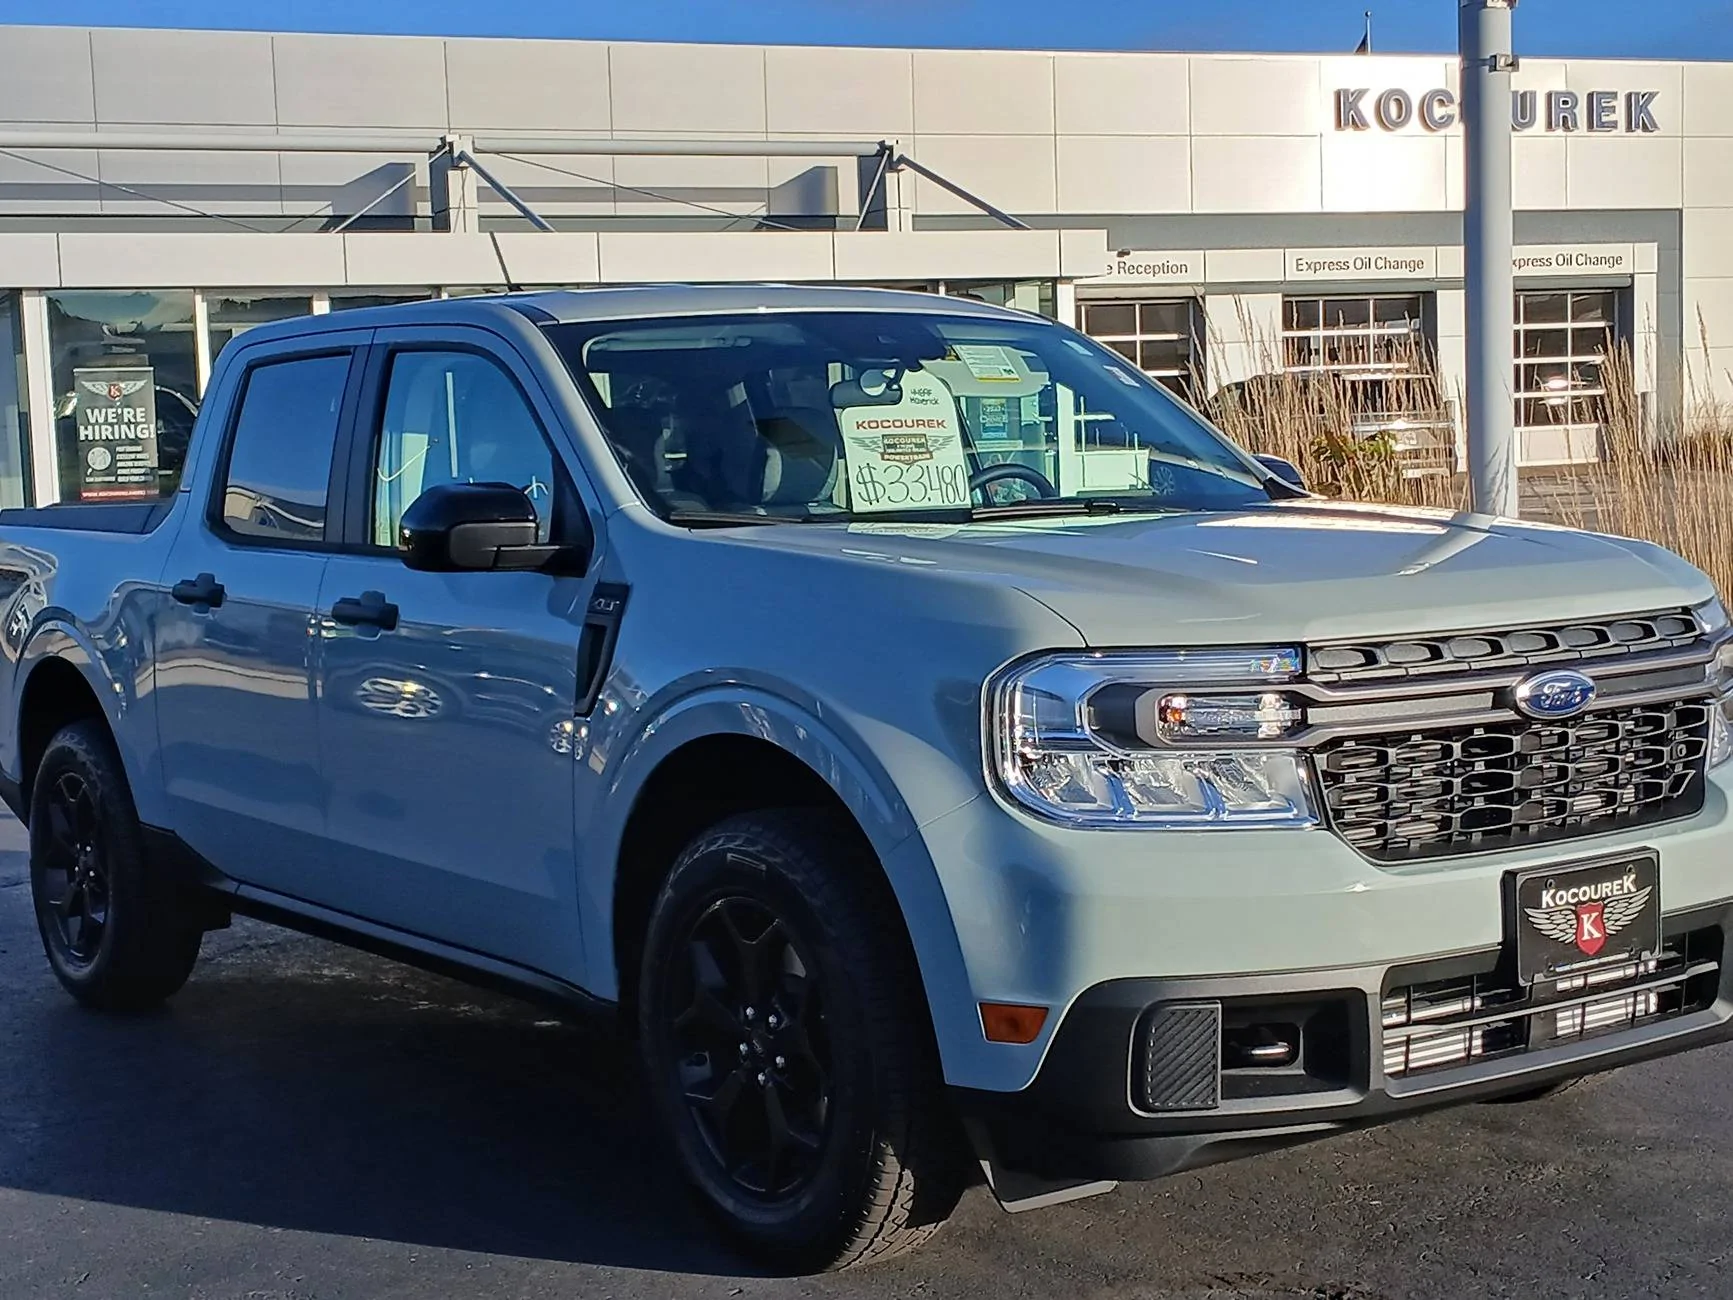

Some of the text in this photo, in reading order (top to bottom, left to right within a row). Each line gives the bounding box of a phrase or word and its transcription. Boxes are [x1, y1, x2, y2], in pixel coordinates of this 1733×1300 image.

[1334, 88, 1660, 132] KOCUREK
[1117, 260, 1188, 277] Reception
[1295, 257, 1424, 274] Express Oil Change
[1512, 253, 1623, 269] xpress Oil Change
[85, 407, 146, 424] WE'RE
[79, 423, 156, 441] HIRING!
[855, 419, 947, 430] KOCOUREK
[1540, 681, 1582, 708] Ford
[1541, 874, 1637, 908] KOCOUREK
[1580, 912, 1602, 941] K
